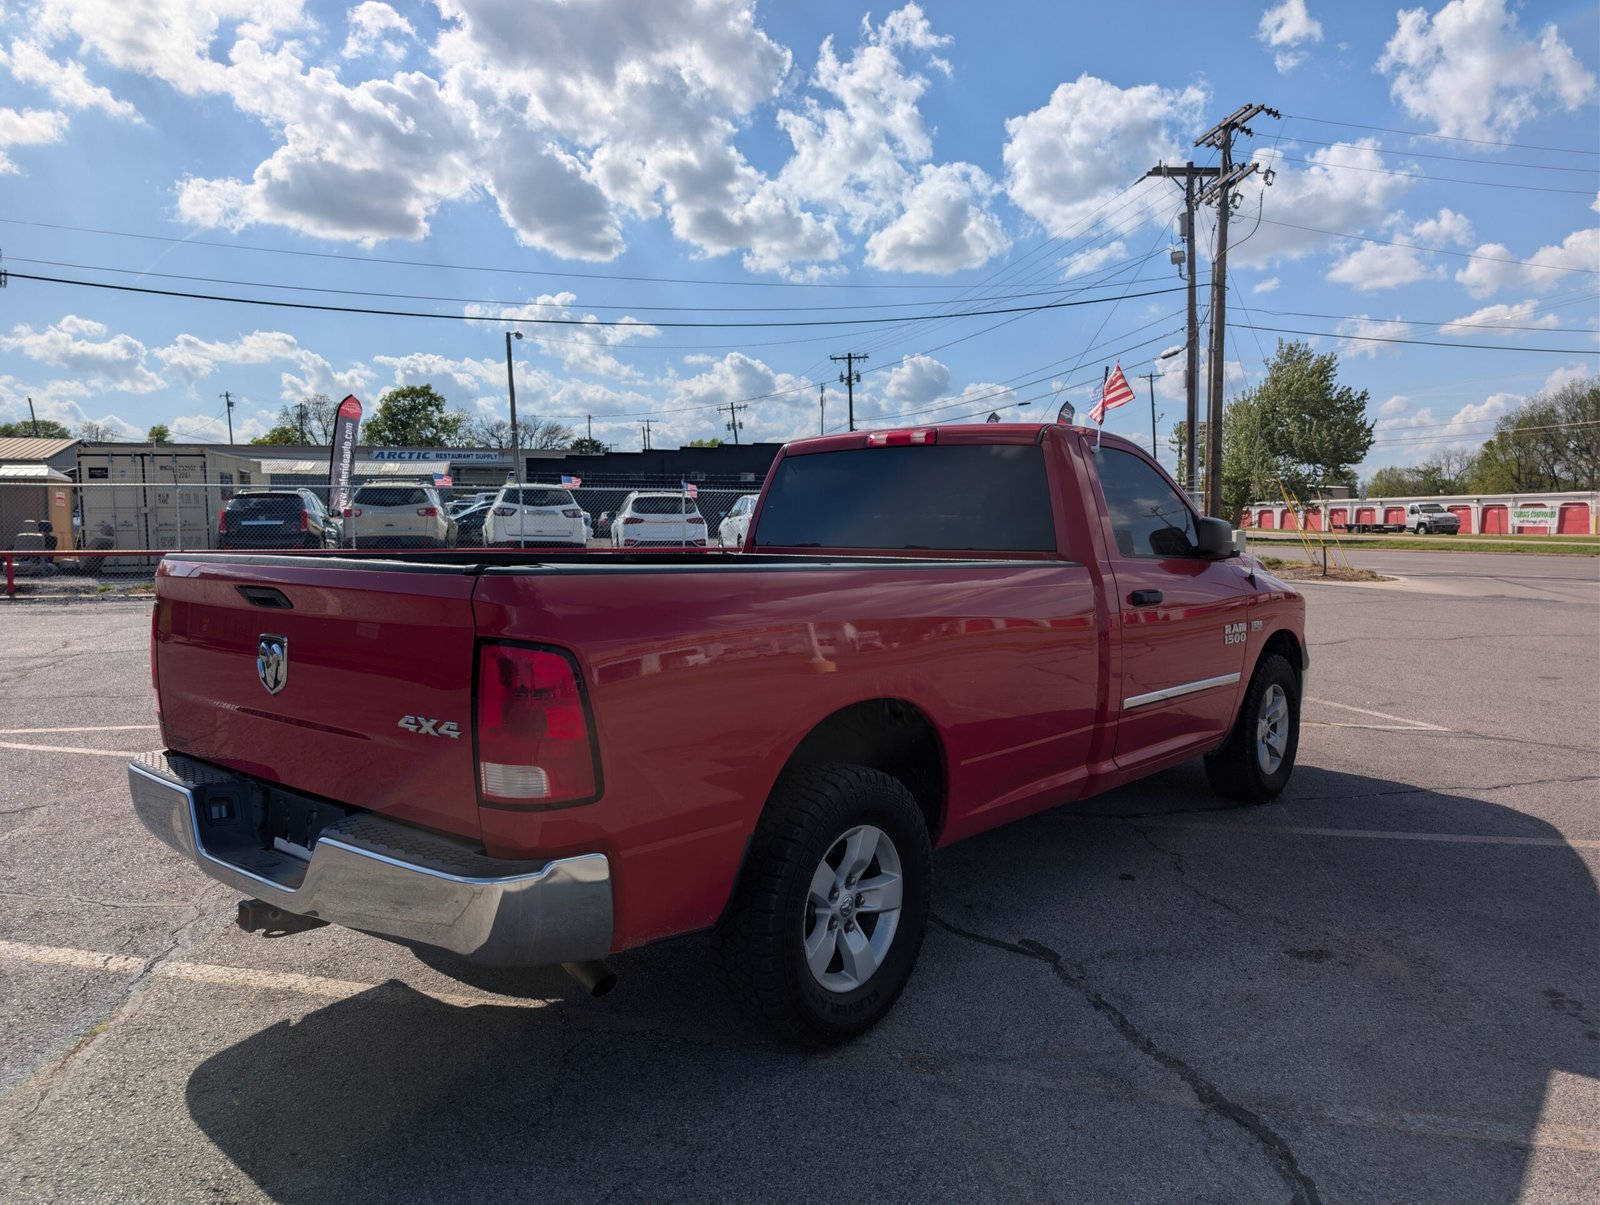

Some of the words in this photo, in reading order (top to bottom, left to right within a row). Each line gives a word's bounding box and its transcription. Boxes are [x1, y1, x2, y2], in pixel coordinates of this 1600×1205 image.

[375, 451, 431, 460] ARCTIC
[435, 452, 474, 460] RESTAURANT
[1225, 622, 1247, 635] RAM
[1225, 633, 1247, 645] 1500
